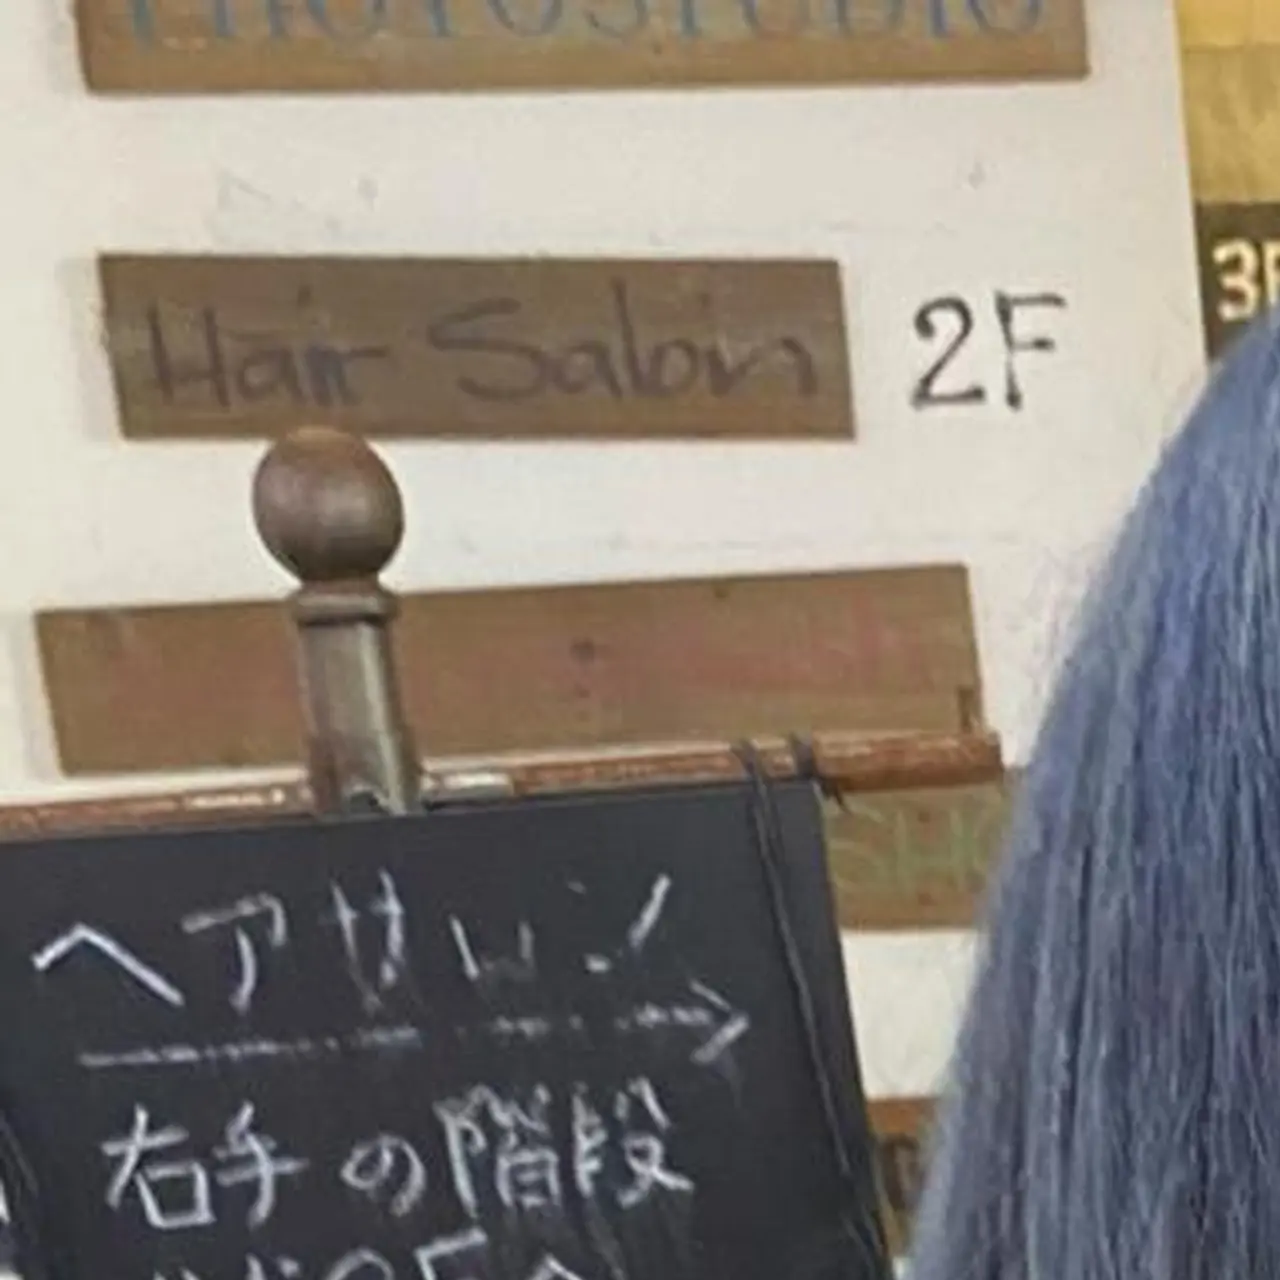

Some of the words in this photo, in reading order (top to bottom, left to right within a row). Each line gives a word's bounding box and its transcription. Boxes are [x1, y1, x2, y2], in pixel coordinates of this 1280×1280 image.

[146, 284, 389, 410] Hair
[428, 277, 819, 401] Salon
[908, 292, 1070, 412] 2F
[100, 1076, 696, 1229] 右手の階段
